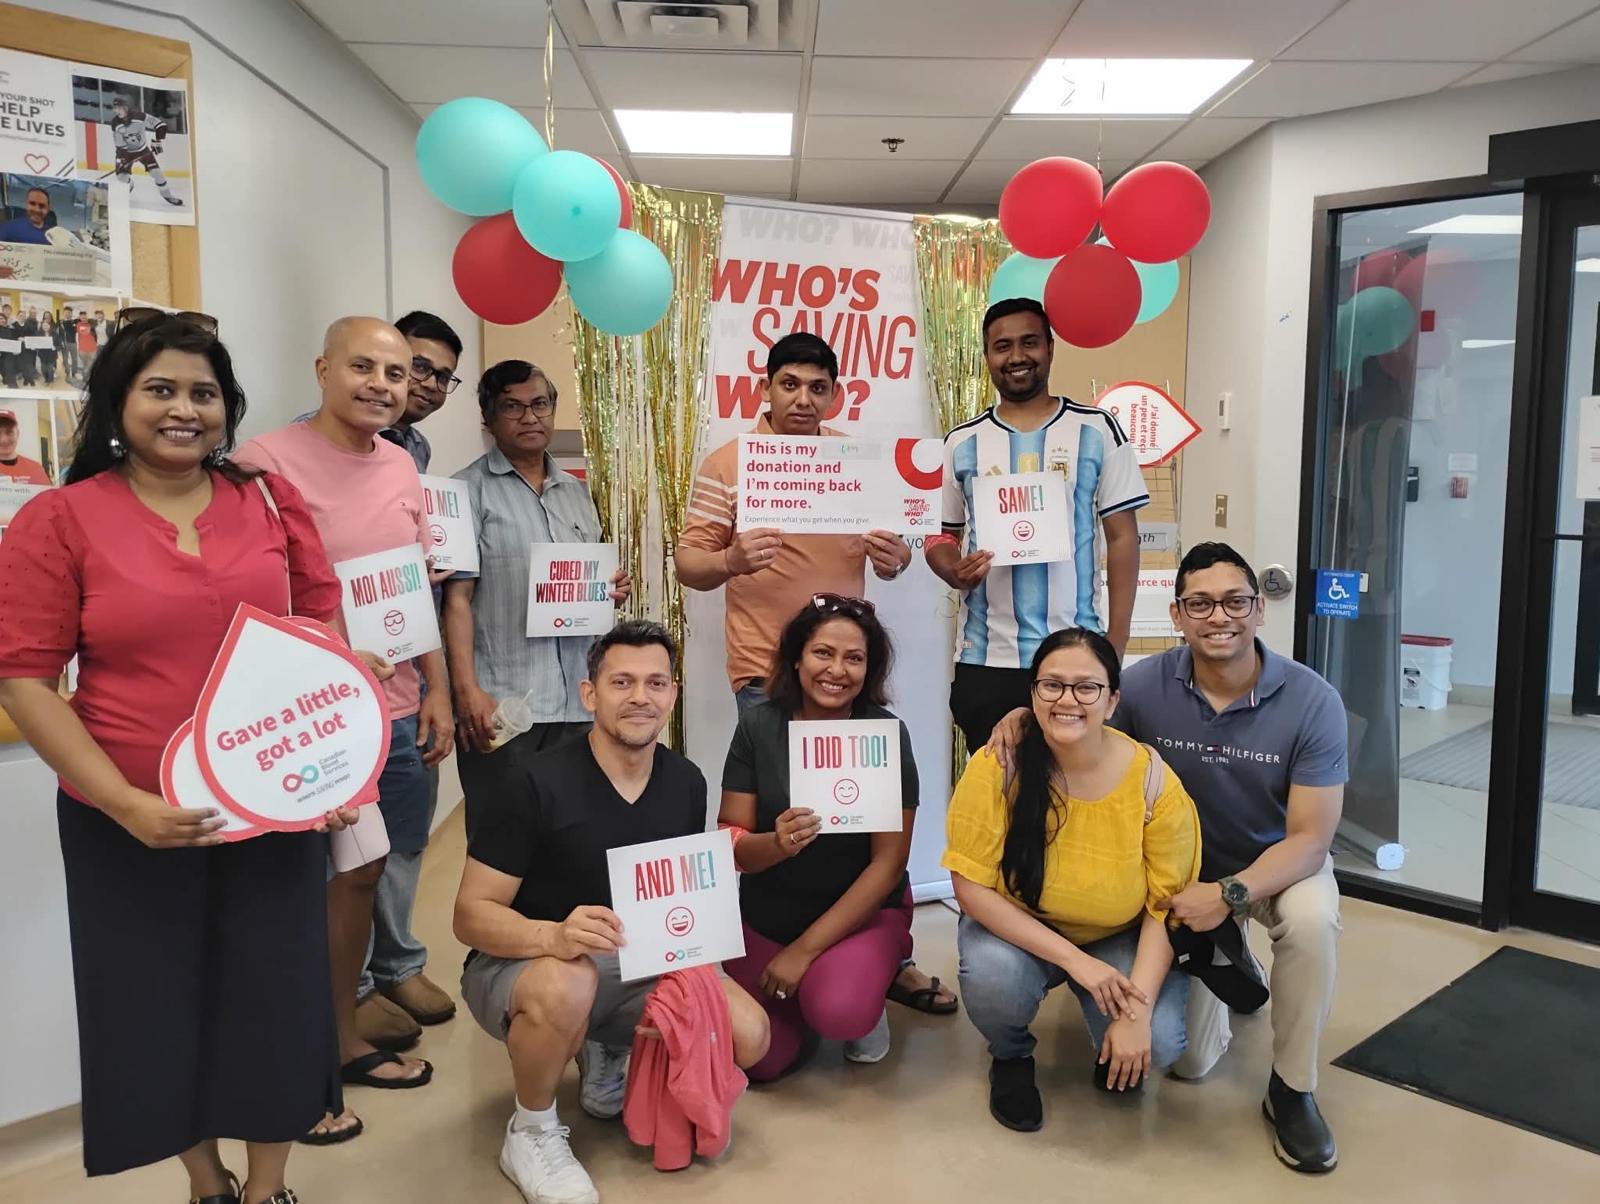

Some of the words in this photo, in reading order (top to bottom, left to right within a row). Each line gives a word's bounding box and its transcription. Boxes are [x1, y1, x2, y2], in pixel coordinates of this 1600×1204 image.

[0, 102, 40, 118] HELP
[29, 96, 56, 107] SHOT
[17, 119, 65, 137] LIVES
[739, 209, 840, 246] WHO?
[711, 258, 881, 311] WHO'S
[716, 374, 871, 421] W?
[1141, 395, 1148, 406] un
[1129, 403, 1138, 443] beaucoup
[1140, 407, 1148, 422] peu
[1140, 424, 1148, 432] et
[1150, 421, 1159, 448] donné
[746, 441, 776, 455] This
[780, 442, 791, 455] is
[795, 446, 817, 458] my
[746, 459, 811, 473] donation
[815, 461, 841, 473] and
[746, 478, 769, 490] I'm
[773, 479, 825, 494] coming
[829, 479, 862, 492] back
[436, 489, 460, 519] ME!
[746, 496, 767, 508] for
[770, 499, 812, 509] more.
[998, 485, 1045, 514] SAME!
[744, 516, 781, 525] Experience
[799, 517, 811, 525] you
[812, 517, 823, 525] get
[823, 516, 842, 524] when
[843, 517, 855, 525] you
[549, 560, 582, 581] CURED
[583, 560, 600, 580] MY
[350, 574, 378, 608] MOI
[380, 562, 422, 600] AUSSI!
[535, 582, 576, 604] WINTER
[576, 582, 610, 603] BLUES.
[217, 716, 278, 751] Gave
[280, 707, 297, 724] a
[295, 681, 361, 717] little,
[255, 735, 296, 772] got
[296, 730, 313, 747] a
[312, 712, 348, 740] lot
[802, 737, 809, 769] I
[814, 735, 843, 769] DID
[848, 735, 888, 769] TOO!
[1156, 737, 1203, 752] TOMMY
[1222, 745, 1281, 764] HILFIGER
[1201, 755, 1215, 763] EST.
[634, 858, 675, 902] AND
[679, 850, 717, 894] ME!
